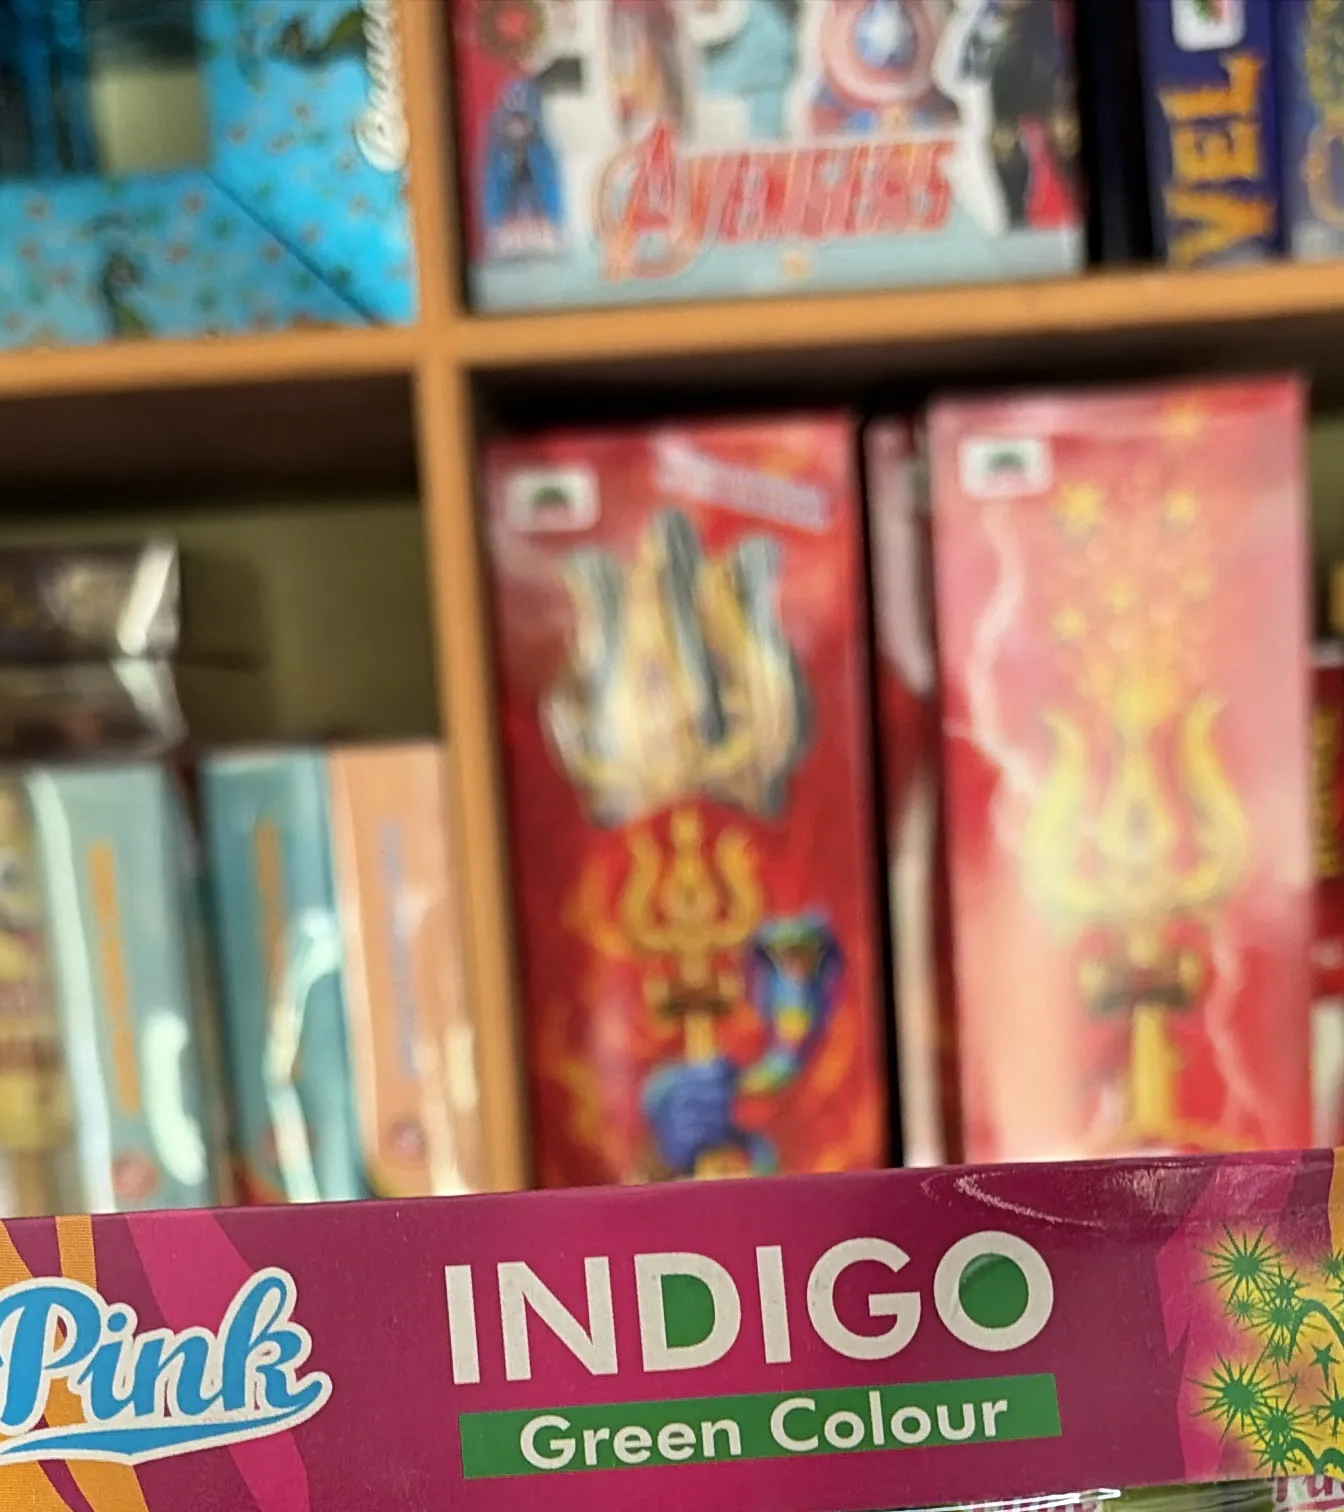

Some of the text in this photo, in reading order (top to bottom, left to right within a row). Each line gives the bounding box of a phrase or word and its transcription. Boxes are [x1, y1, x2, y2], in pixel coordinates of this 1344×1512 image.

[1160, 54, 1270, 266] VEL
[444, 1230, 1054, 1386] INDIGO
[519, 1390, 1009, 1471] Green Colour
